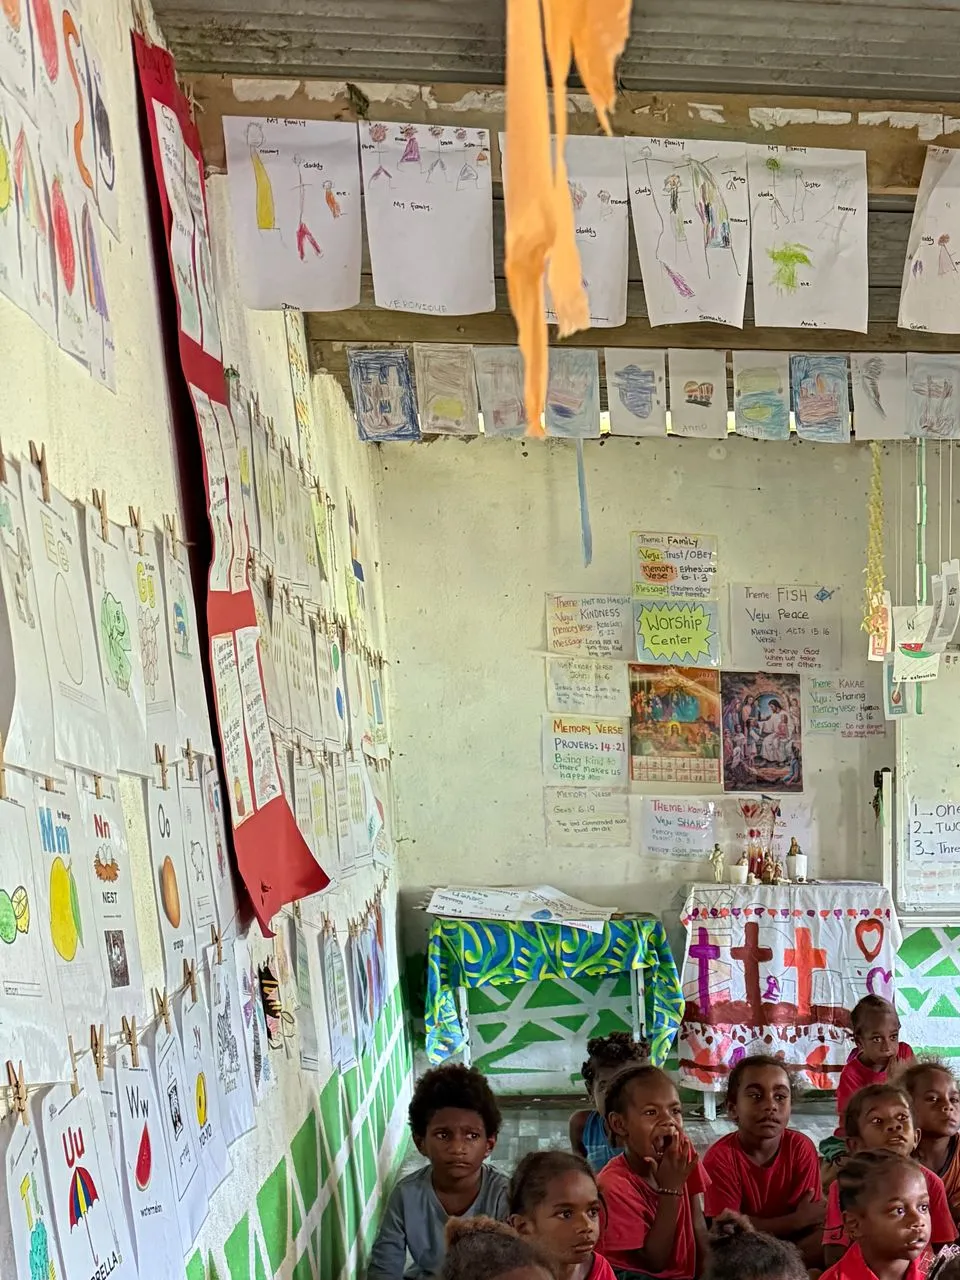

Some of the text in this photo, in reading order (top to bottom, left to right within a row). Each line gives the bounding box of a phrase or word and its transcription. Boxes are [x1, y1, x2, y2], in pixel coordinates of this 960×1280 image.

[777, 588, 807, 602] FISH
[778, 609, 809, 620] Peace
[651, 634, 692, 645] Center
[94, 814, 110, 839] Nn
[913, 821, 922, 834] 2
[913, 840, 925, 855] 3
[102, 892, 117, 904] NEST
[126, 1085, 149, 1119] Ww
[62, 1126, 85, 1168] Uu
